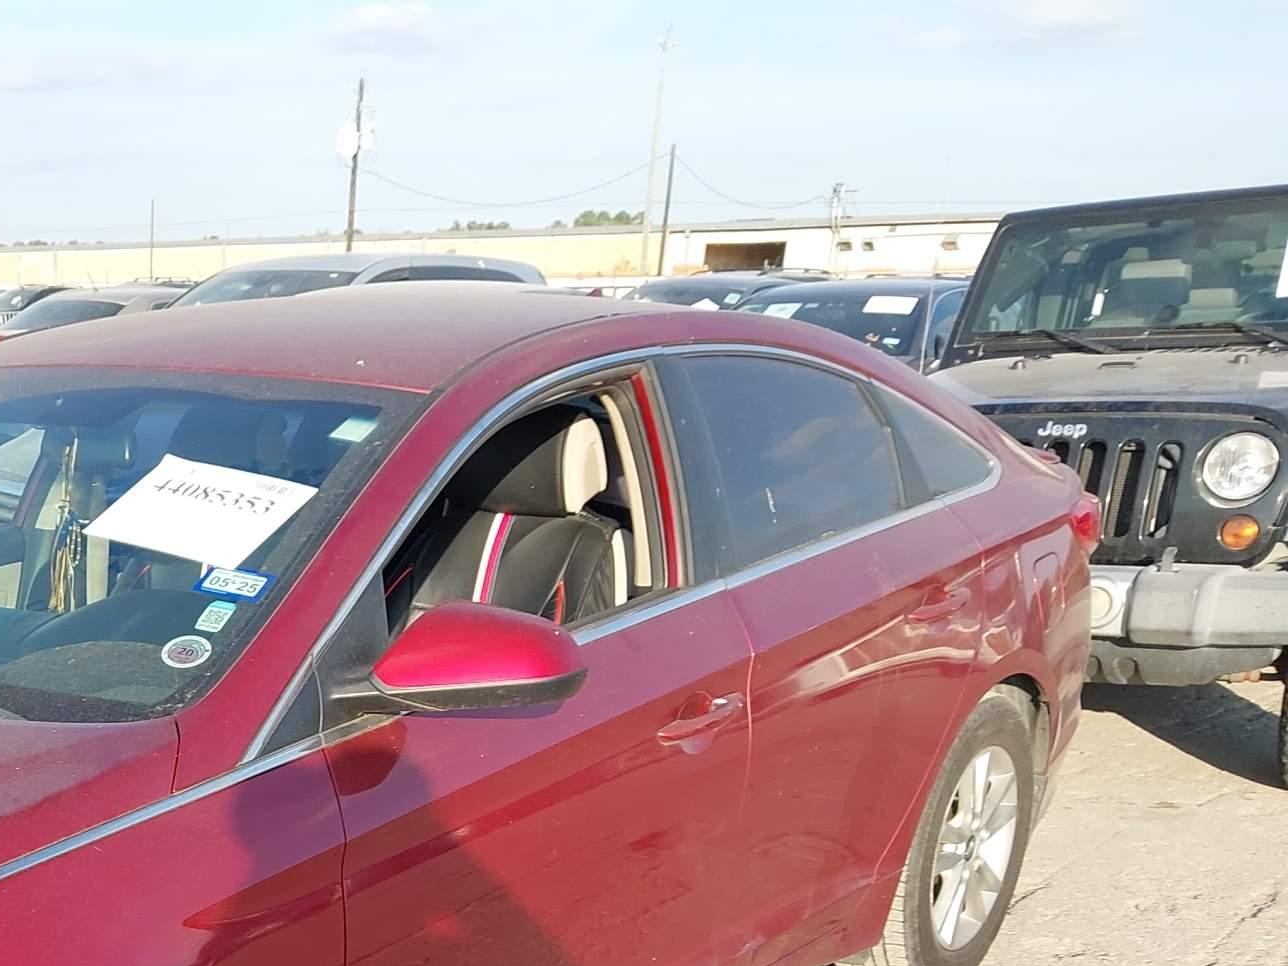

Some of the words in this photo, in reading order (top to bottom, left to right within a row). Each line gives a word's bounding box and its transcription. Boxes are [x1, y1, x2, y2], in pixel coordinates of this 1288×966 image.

[1037, 420, 1088, 439] Jeep
[153, 478, 276, 514] 44085353
[208, 575, 231, 588] 05
[235, 581, 261, 594] 25
